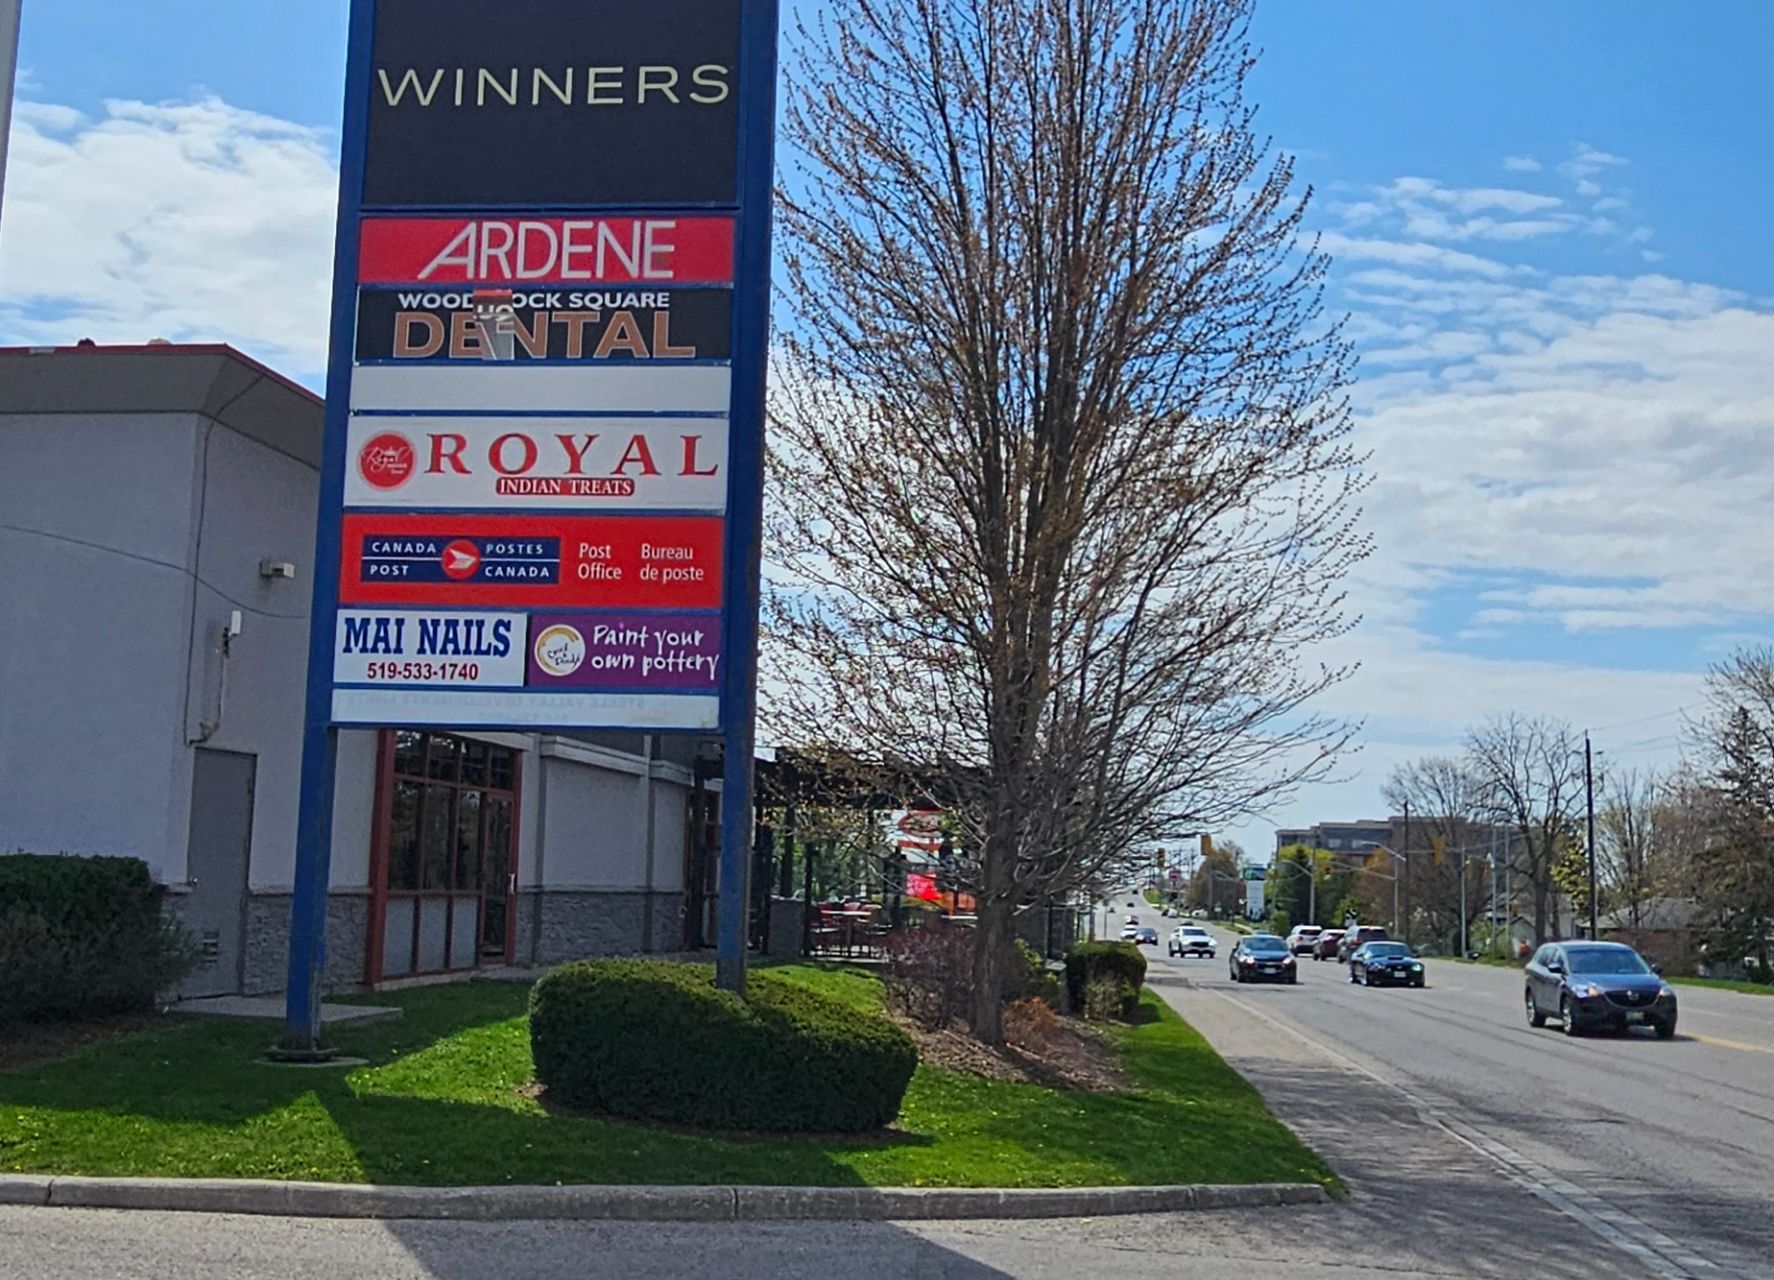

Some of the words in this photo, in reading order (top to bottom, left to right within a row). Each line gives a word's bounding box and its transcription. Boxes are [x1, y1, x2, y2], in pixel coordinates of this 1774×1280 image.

[377, 64, 730, 107] WINNERS
[417, 220, 676, 280] ARDENE
[398, 292, 562, 309] WOODOCK
[569, 292, 670, 309] SQUARE
[392, 311, 696, 359] DENTAL
[424, 433, 718, 477] ROYAL
[500, 479, 561, 495] INDIAN
[569, 479, 632, 495] TREATS
[371, 542, 437, 554] CANADA
[486, 543, 544, 555] POSTES
[579, 543, 611, 560] Post
[640, 543, 694, 560] Bureau
[370, 564, 409, 577] POST
[485, 566, 550, 578] CANADA
[578, 563, 622, 580] Office
[640, 564, 659, 581] de
[663, 566, 704, 584] poste
[342, 617, 404, 654] MAI
[416, 618, 512, 658] NAILS
[592, 623, 648, 646] Paint
[654, 631, 704, 657] your
[366, 662, 479, 681] 519-533-1740
[591, 653, 635, 670] own
[642, 652, 720, 680] pottery
